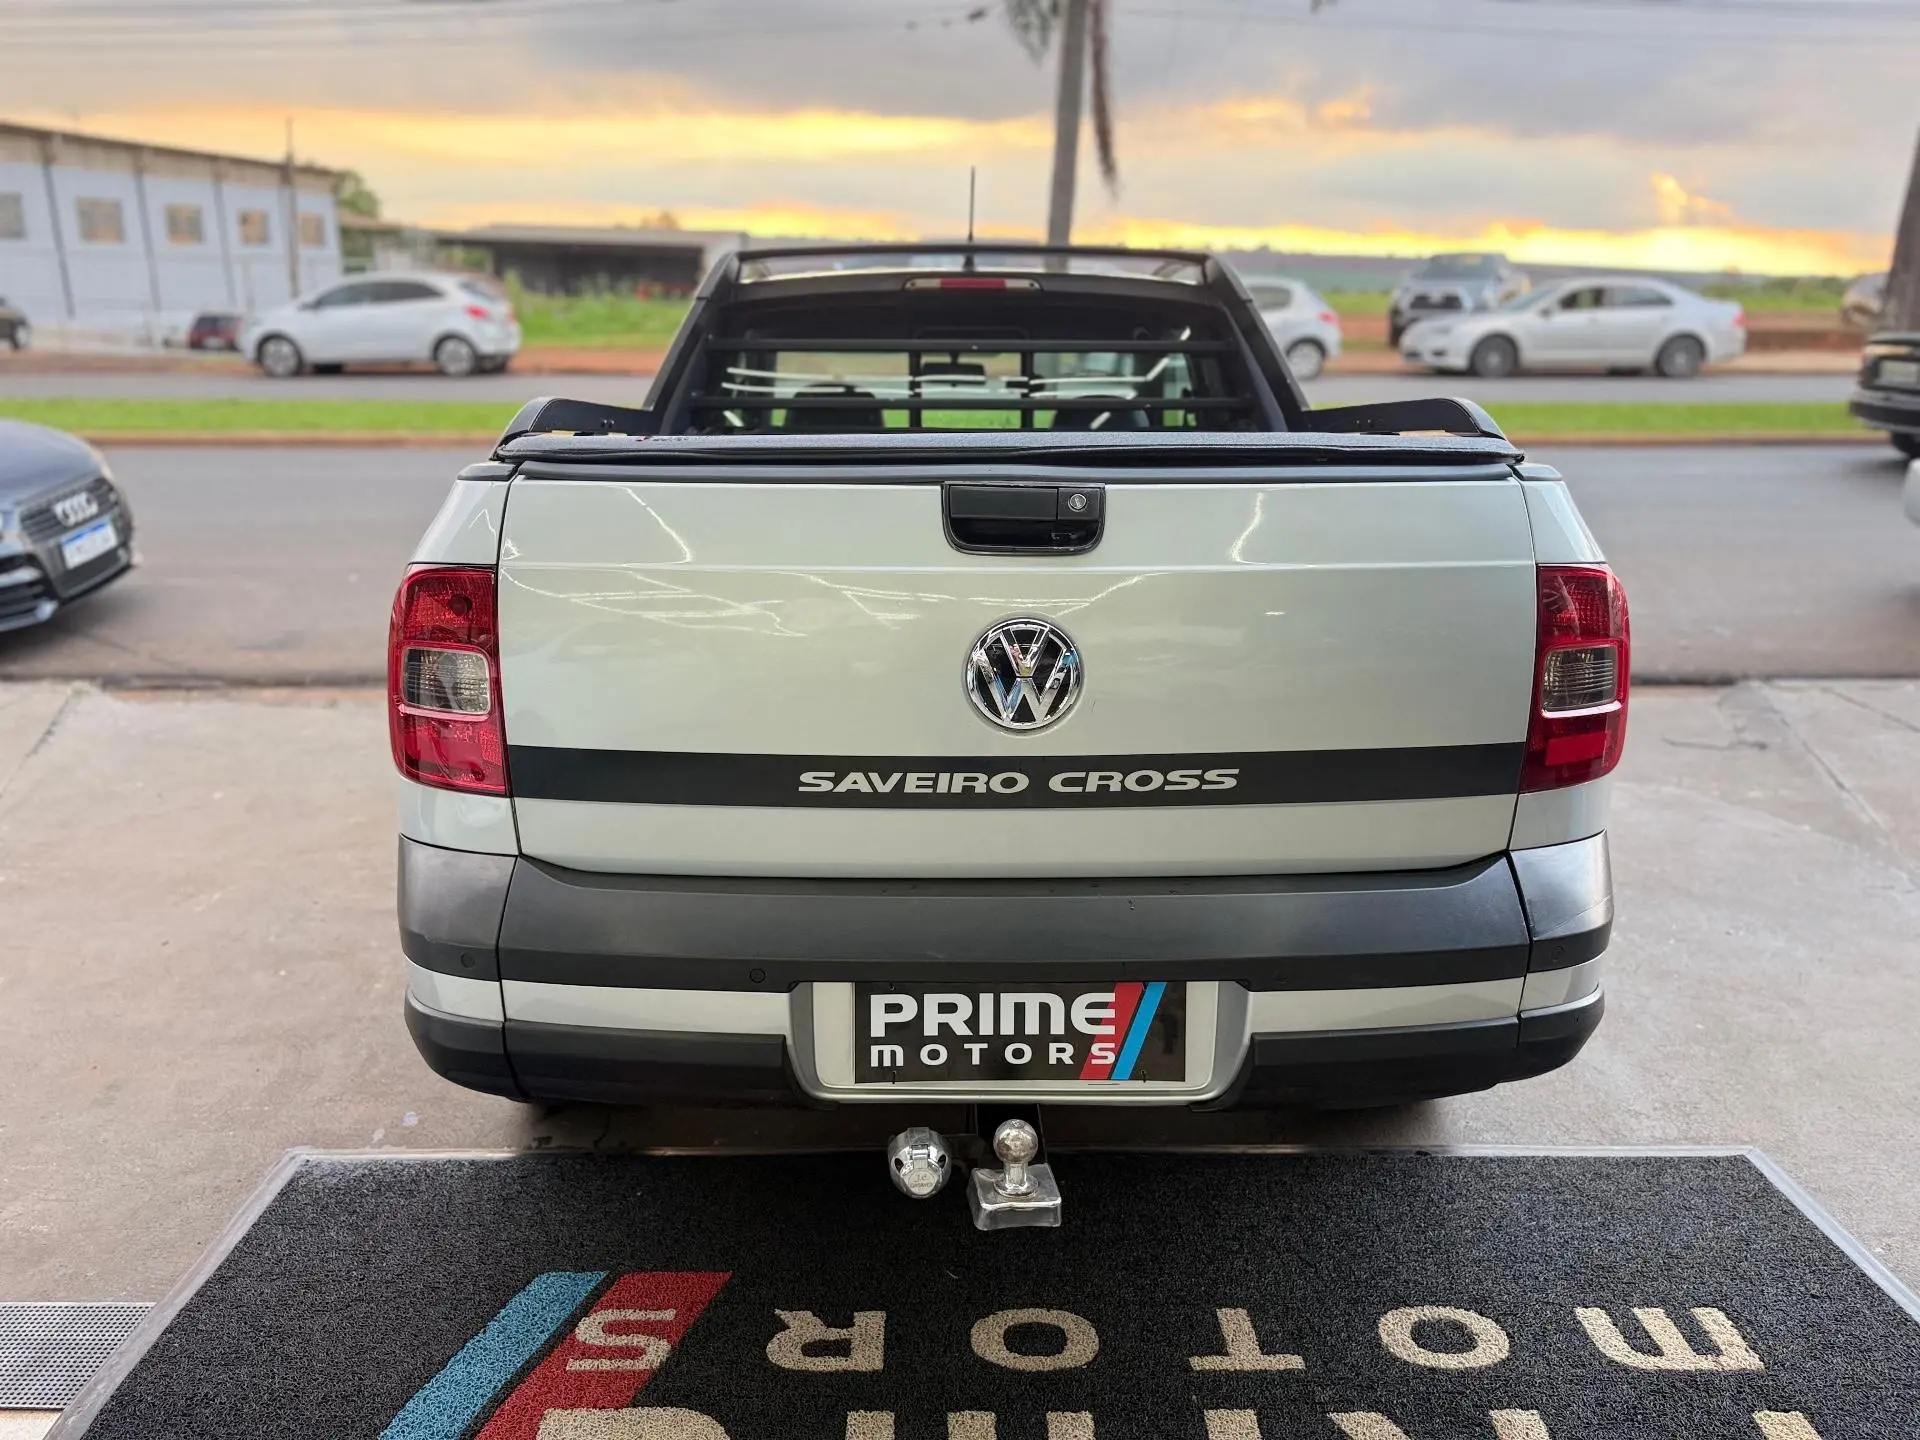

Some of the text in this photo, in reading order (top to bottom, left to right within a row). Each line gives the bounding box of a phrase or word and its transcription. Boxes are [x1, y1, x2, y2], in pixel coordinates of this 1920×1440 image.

[798, 768, 1240, 794] SAVEIRO CROSS
[869, 992, 1116, 1038] PRIME
[869, 1042, 1117, 1068] MOTORS
[566, 1305, 1765, 1373] MOTORS
